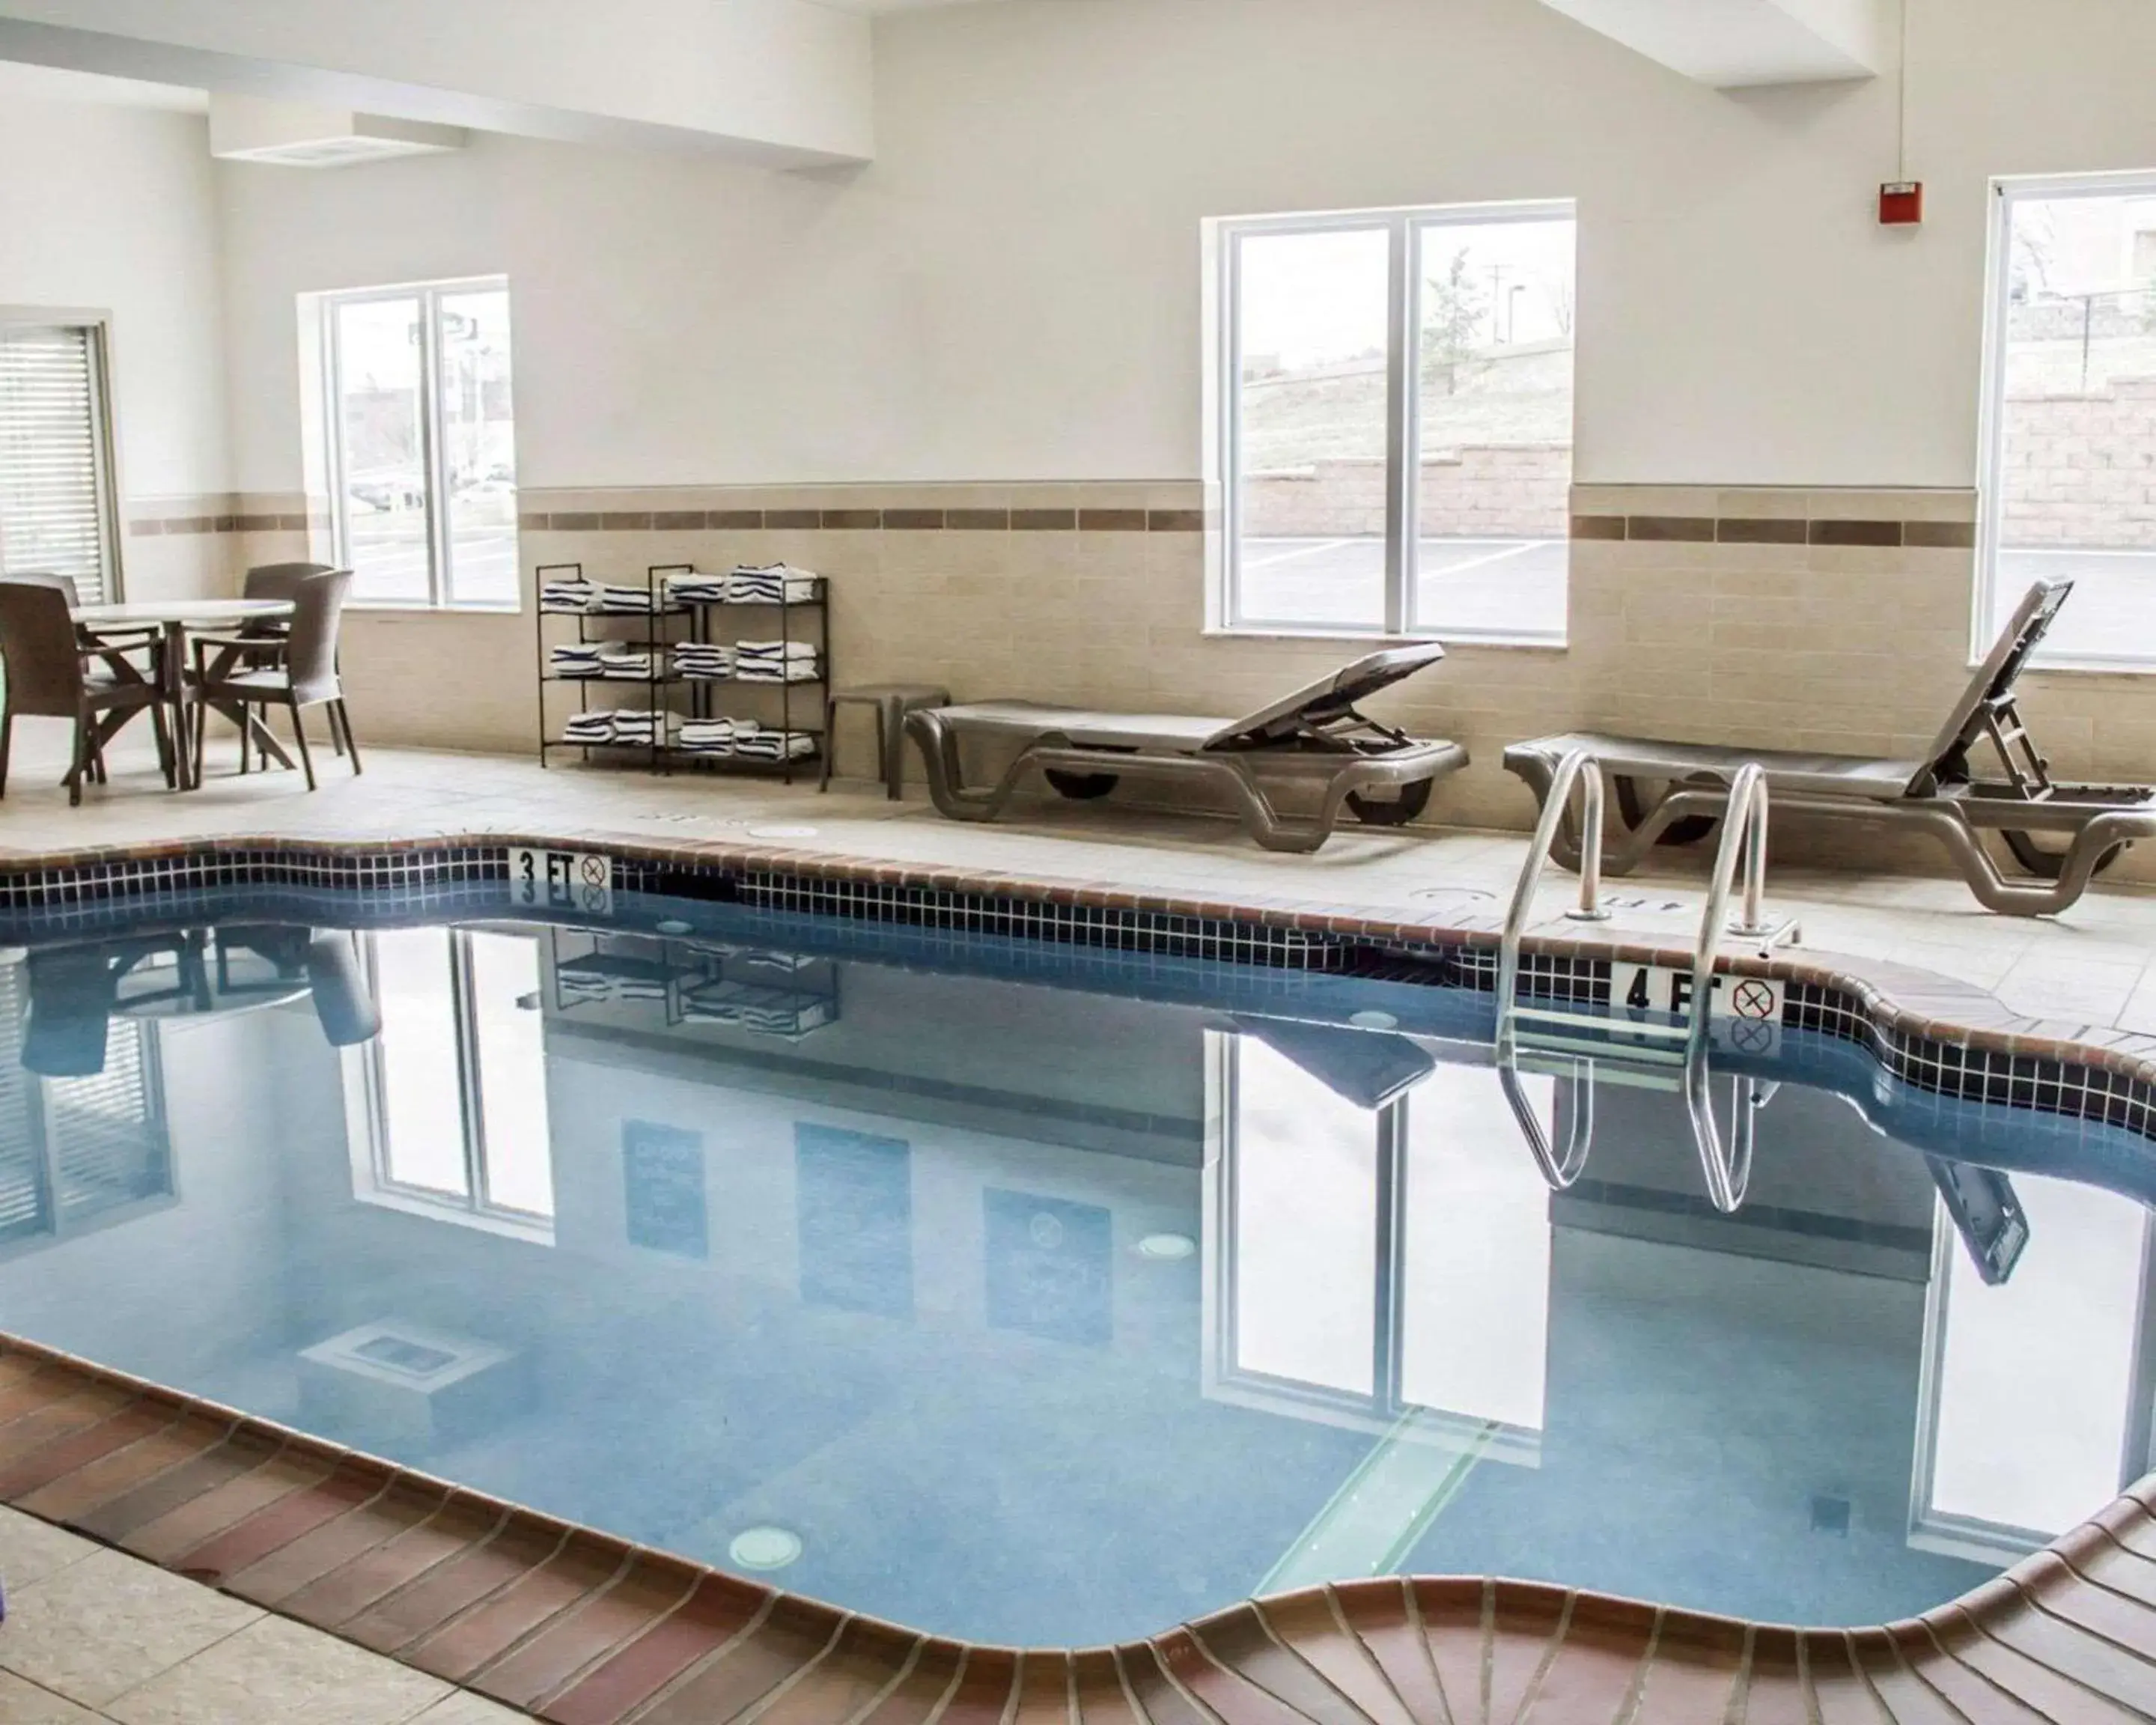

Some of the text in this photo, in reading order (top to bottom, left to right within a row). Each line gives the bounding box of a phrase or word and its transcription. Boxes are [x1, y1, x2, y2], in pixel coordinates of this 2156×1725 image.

[520, 851, 575, 885] 3 FT
[1626, 967, 1650, 1008] 4
